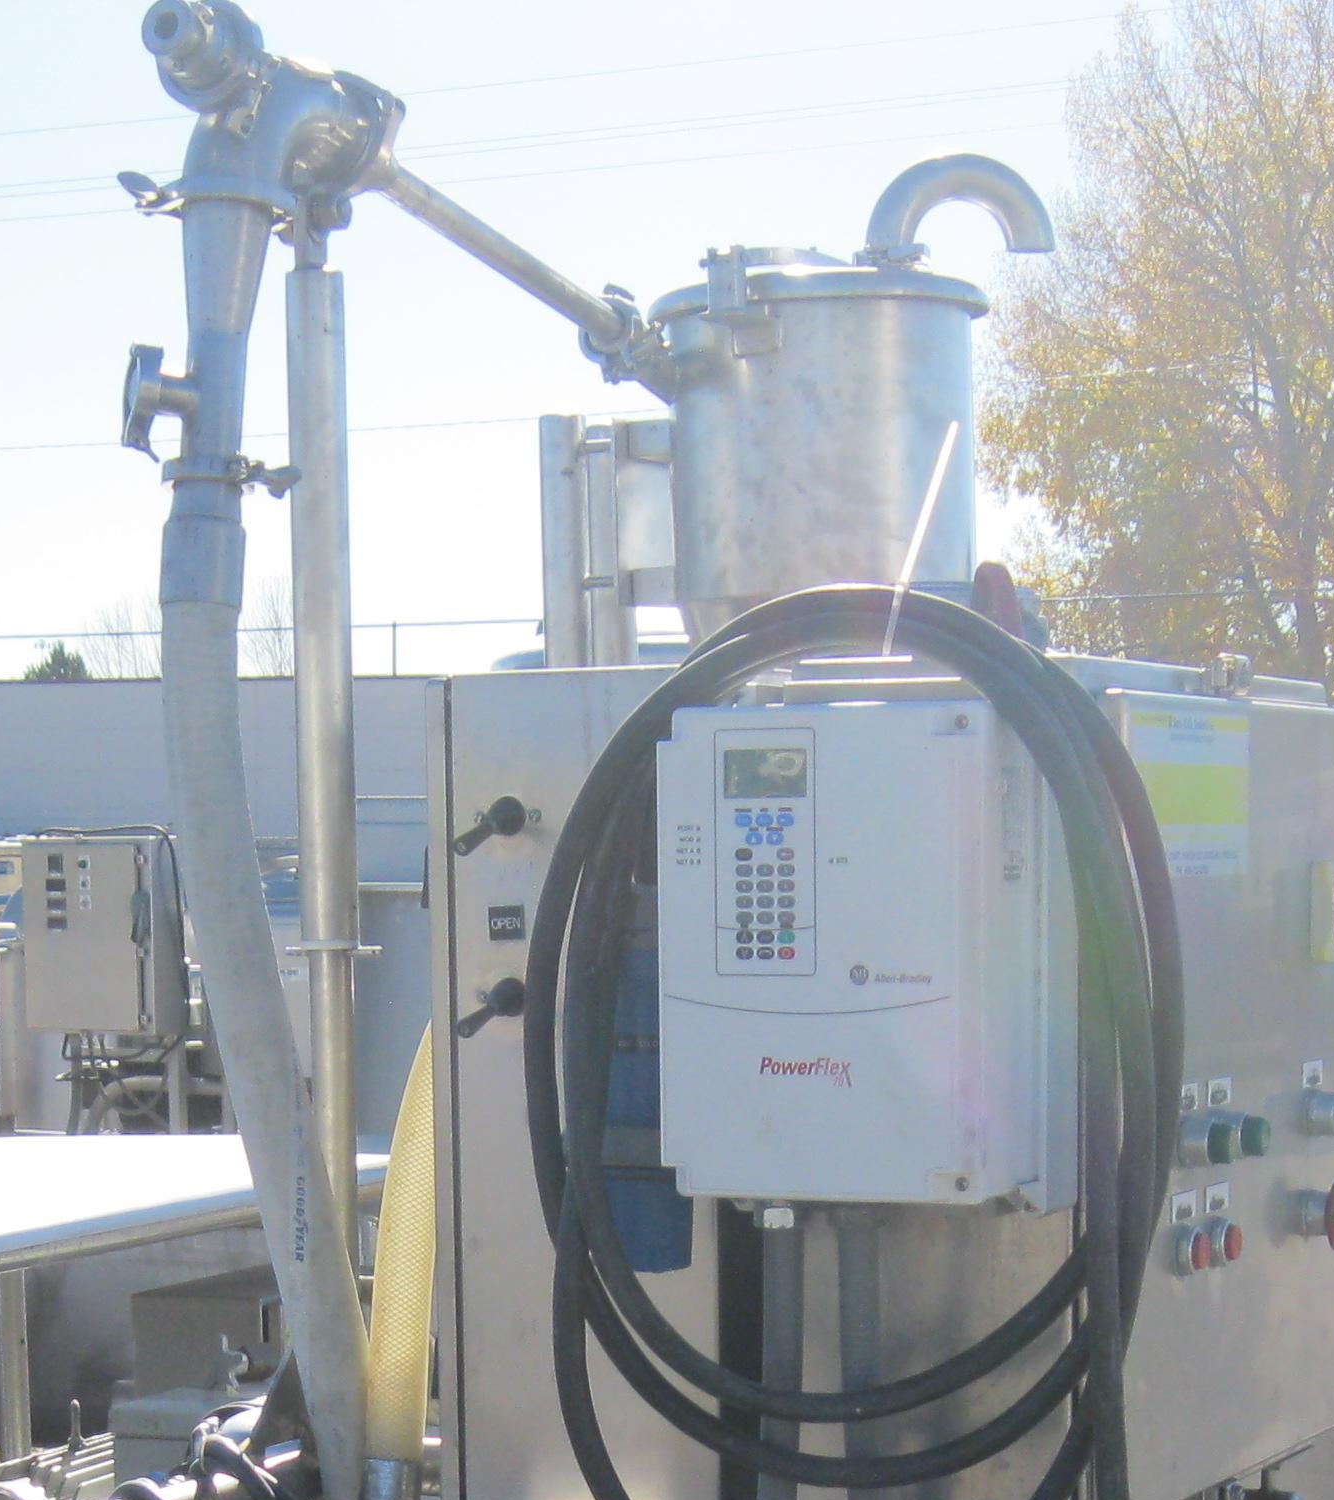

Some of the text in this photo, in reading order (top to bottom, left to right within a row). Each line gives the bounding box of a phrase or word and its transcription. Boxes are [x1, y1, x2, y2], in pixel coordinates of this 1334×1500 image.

[491, 917, 521, 930] OPEN
[760, 1056, 852, 1088] PowerFlex
[294, 1176, 309, 1263] GOODYEAR
